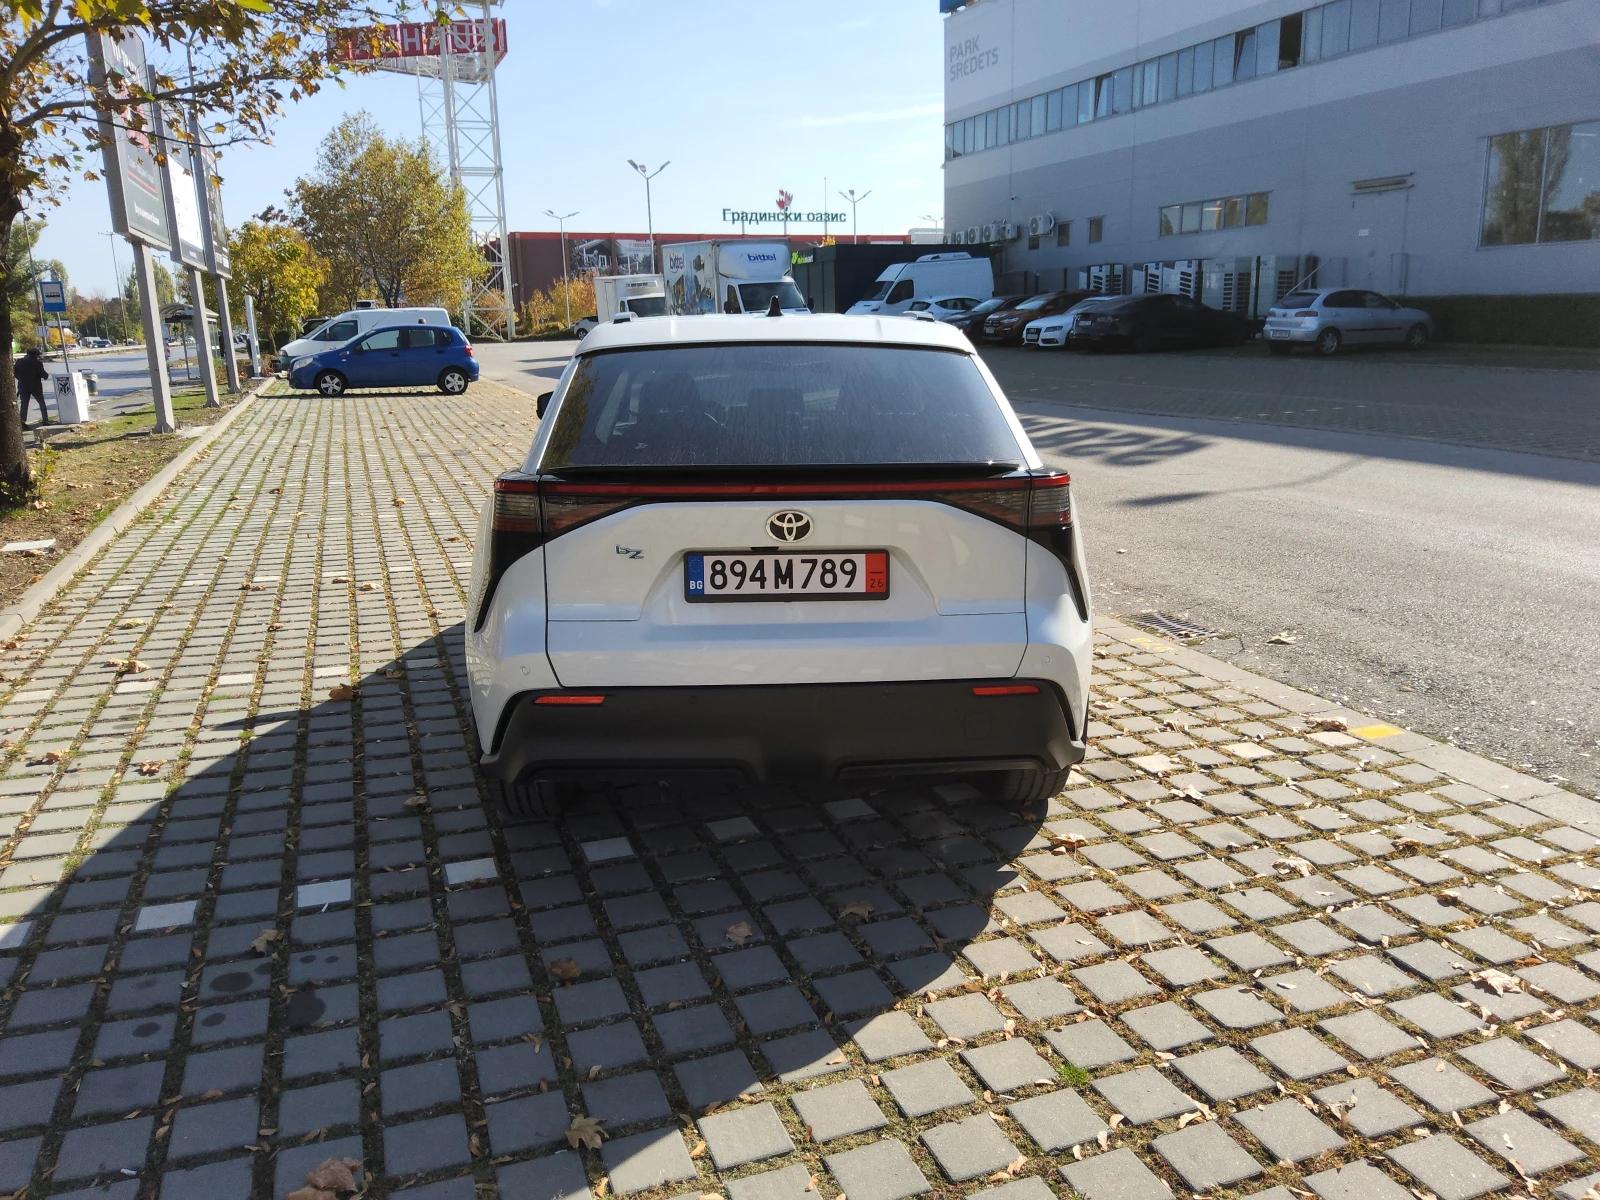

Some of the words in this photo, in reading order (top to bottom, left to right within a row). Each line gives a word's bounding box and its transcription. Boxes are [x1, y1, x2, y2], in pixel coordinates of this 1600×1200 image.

[950, 34, 980, 63] PARK
[950, 46, 999, 82] SREDETS
[722, 207, 802, 225] Градински
[807, 211, 847, 223] оазис
[747, 252, 777, 262] bittel
[689, 580, 703, 590] BG
[869, 577, 884, 589] 26
